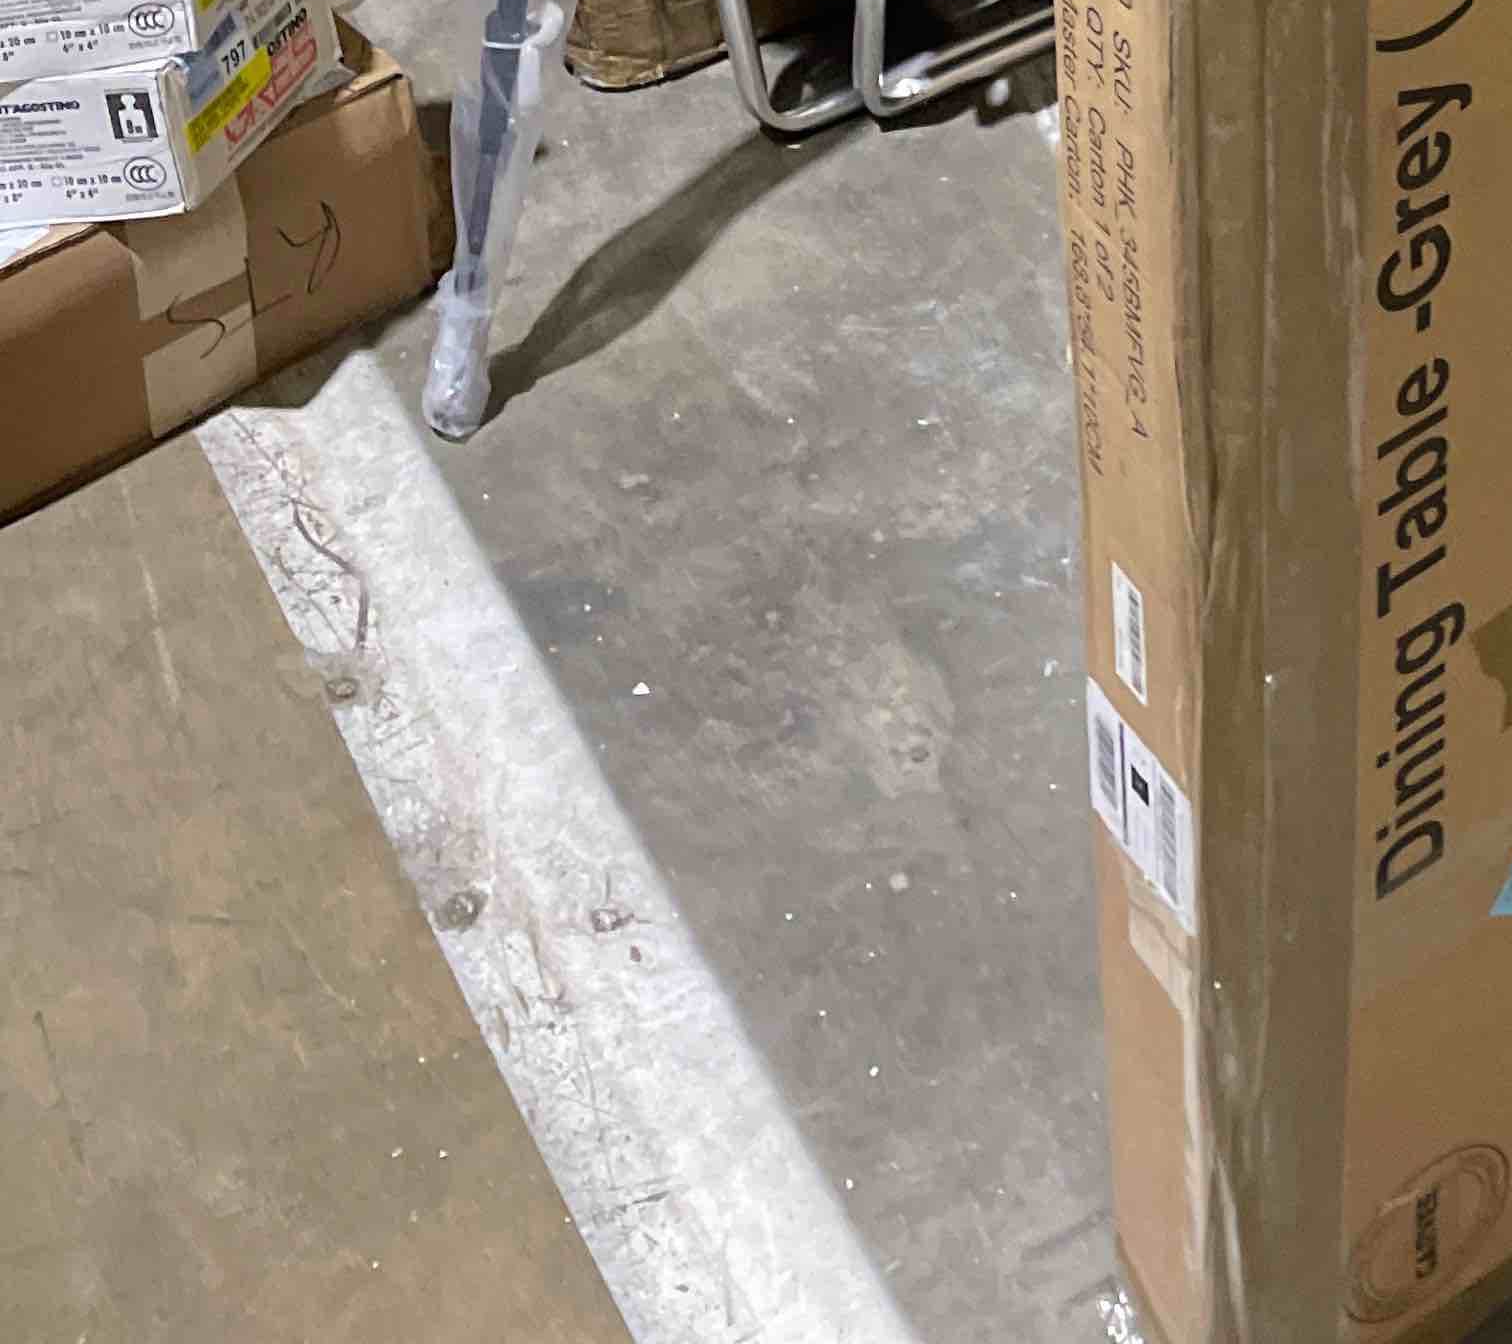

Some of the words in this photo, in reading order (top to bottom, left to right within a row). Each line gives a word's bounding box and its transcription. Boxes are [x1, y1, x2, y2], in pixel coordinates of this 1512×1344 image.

[221, 41, 248, 75] 797
[1112, 30, 1134, 115] SKU:
[1087, 105, 1110, 210] Carton
[1372, 356, 1452, 615] Table
[1373, 602, 1466, 902] Dining
